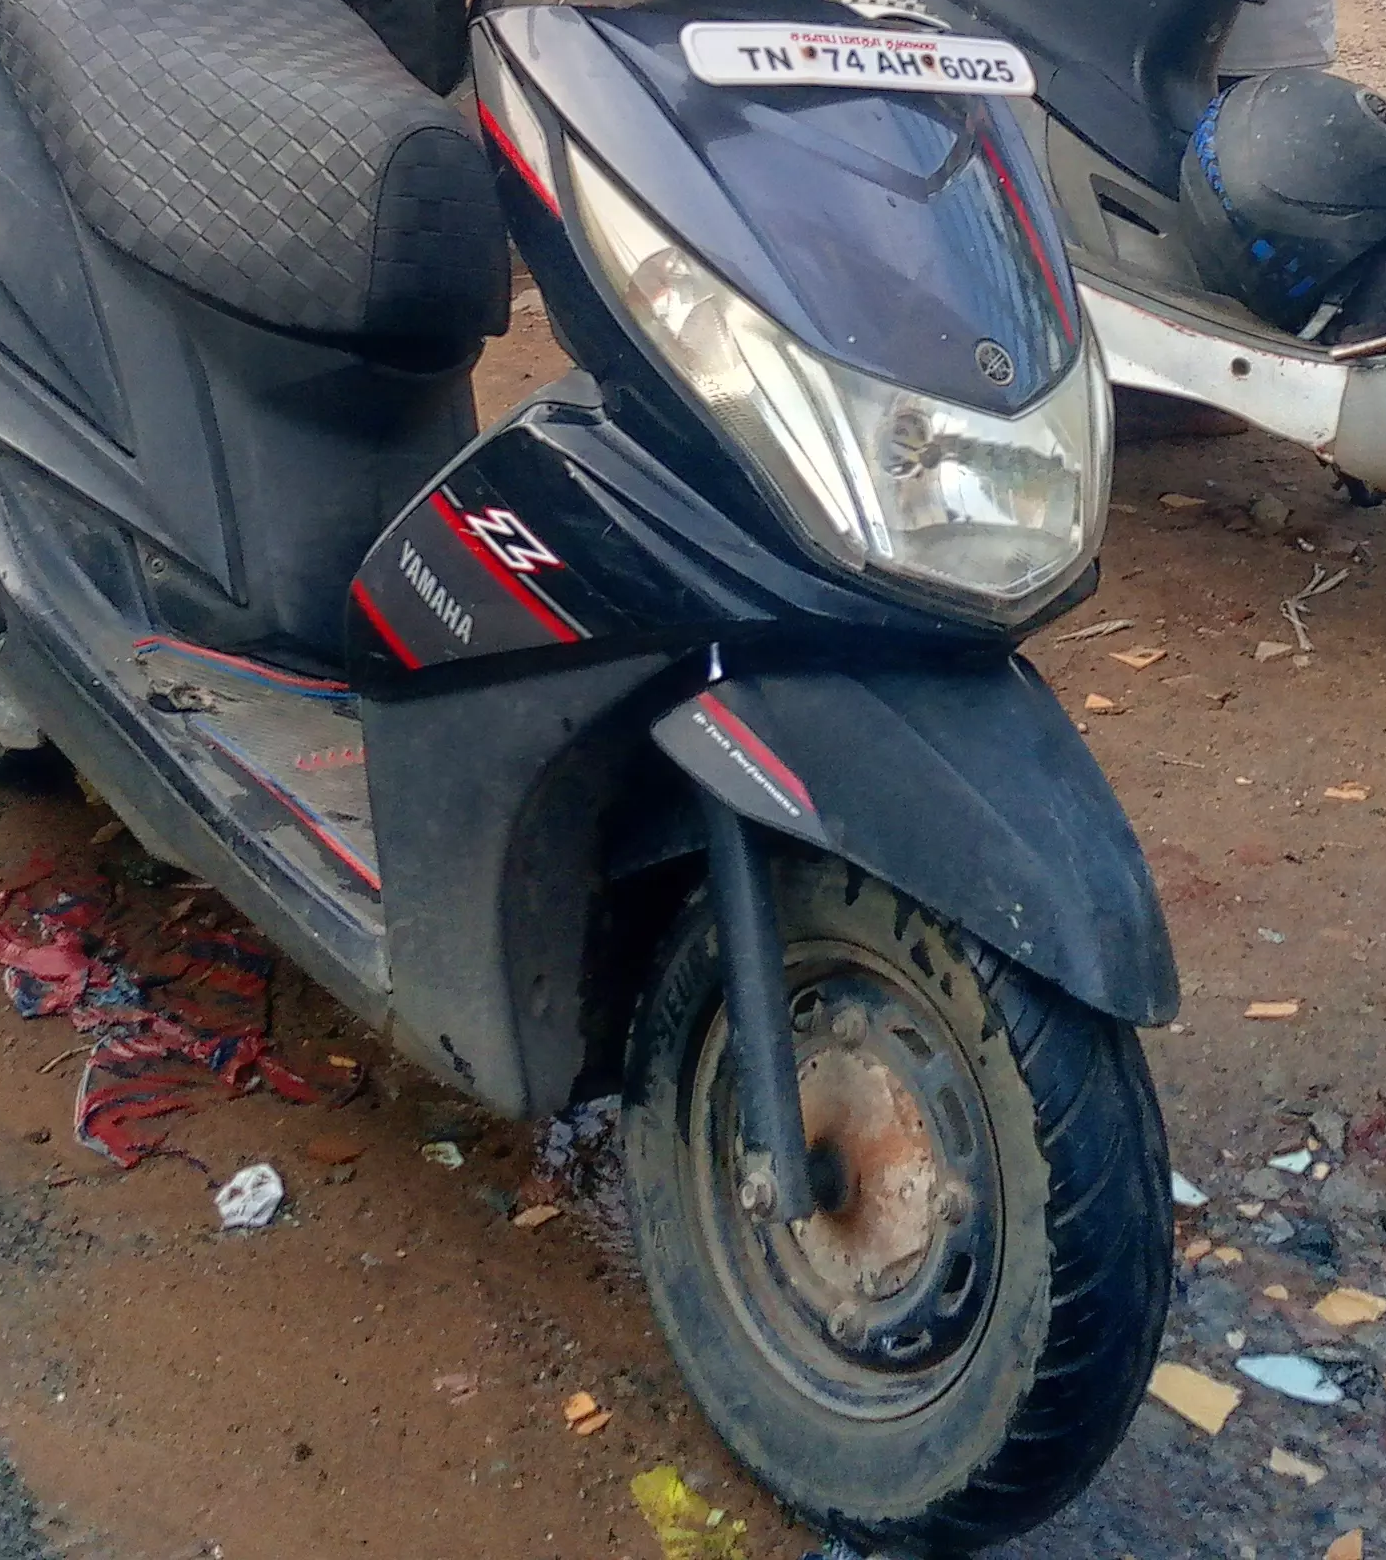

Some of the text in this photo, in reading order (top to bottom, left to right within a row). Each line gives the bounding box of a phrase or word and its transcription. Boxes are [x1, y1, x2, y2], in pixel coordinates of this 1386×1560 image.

[739, 46, 1014, 84] TN 74 AH 6025
[398, 539, 474, 645] YAMAHA
